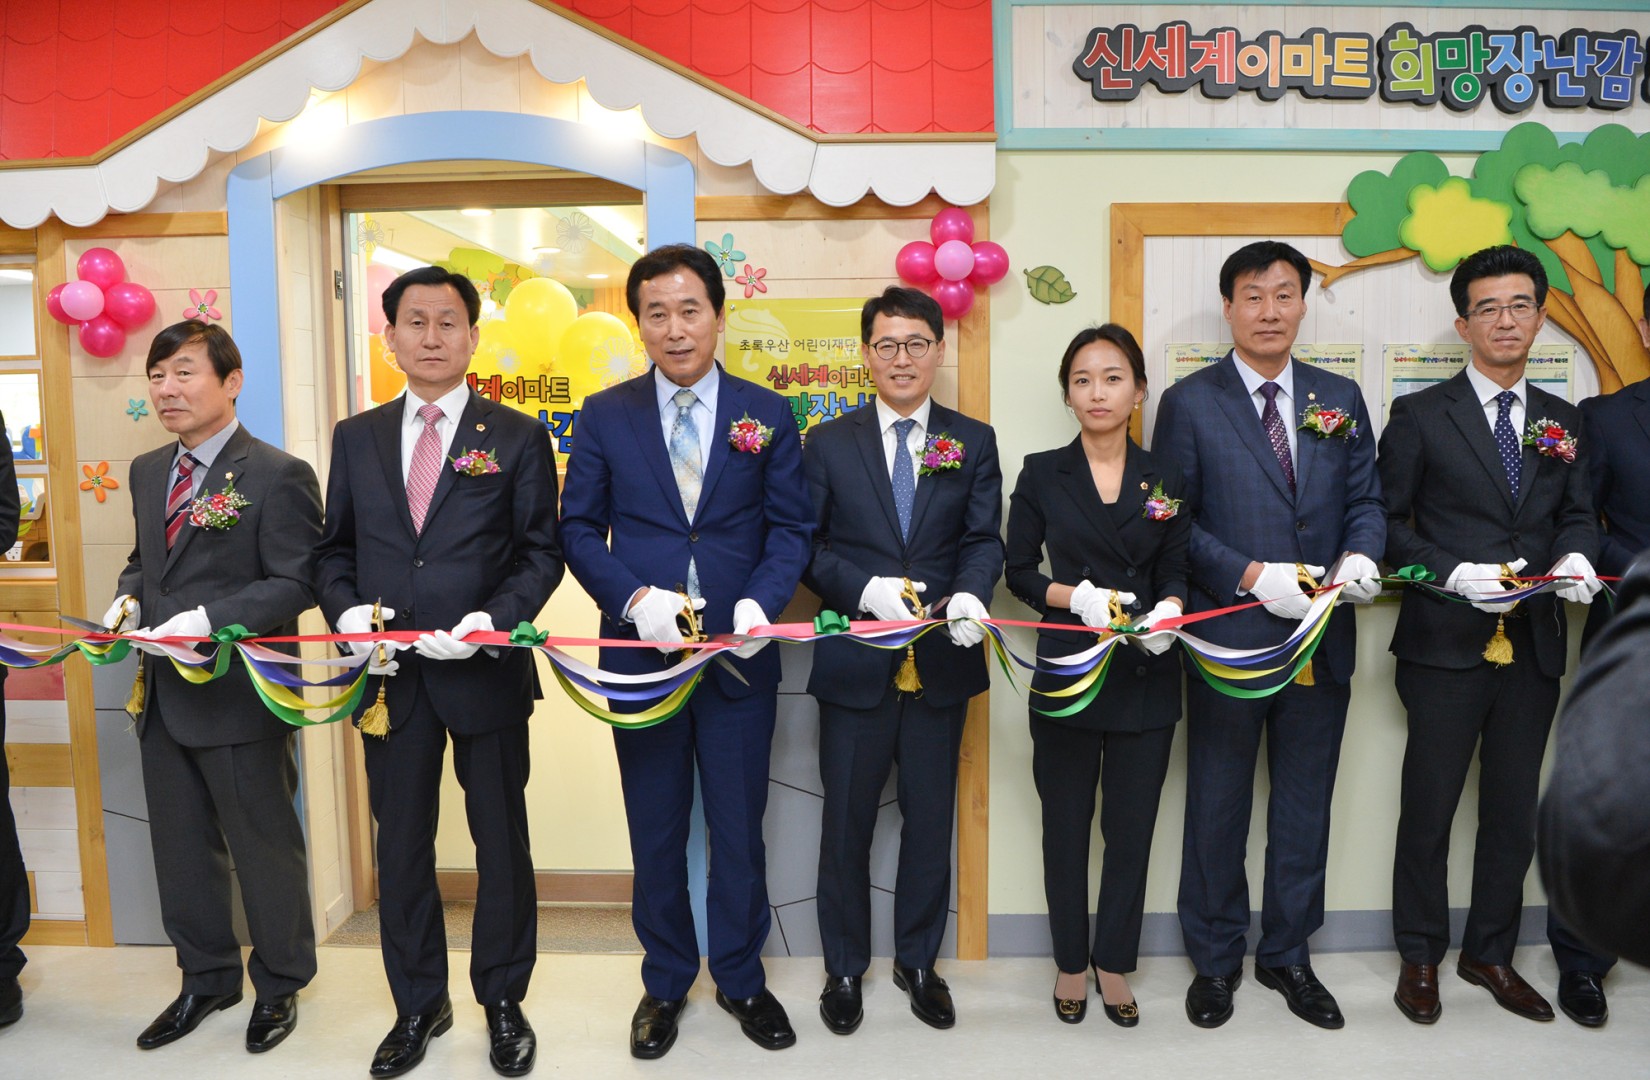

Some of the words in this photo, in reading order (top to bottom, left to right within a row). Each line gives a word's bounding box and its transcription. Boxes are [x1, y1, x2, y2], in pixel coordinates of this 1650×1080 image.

[1083, 24, 1373, 90] 신세계이마트
[1389, 29, 1643, 103] 희망장난감
[739, 339, 790, 353] 초록우산
[793, 338, 857, 353] 어린이재단
